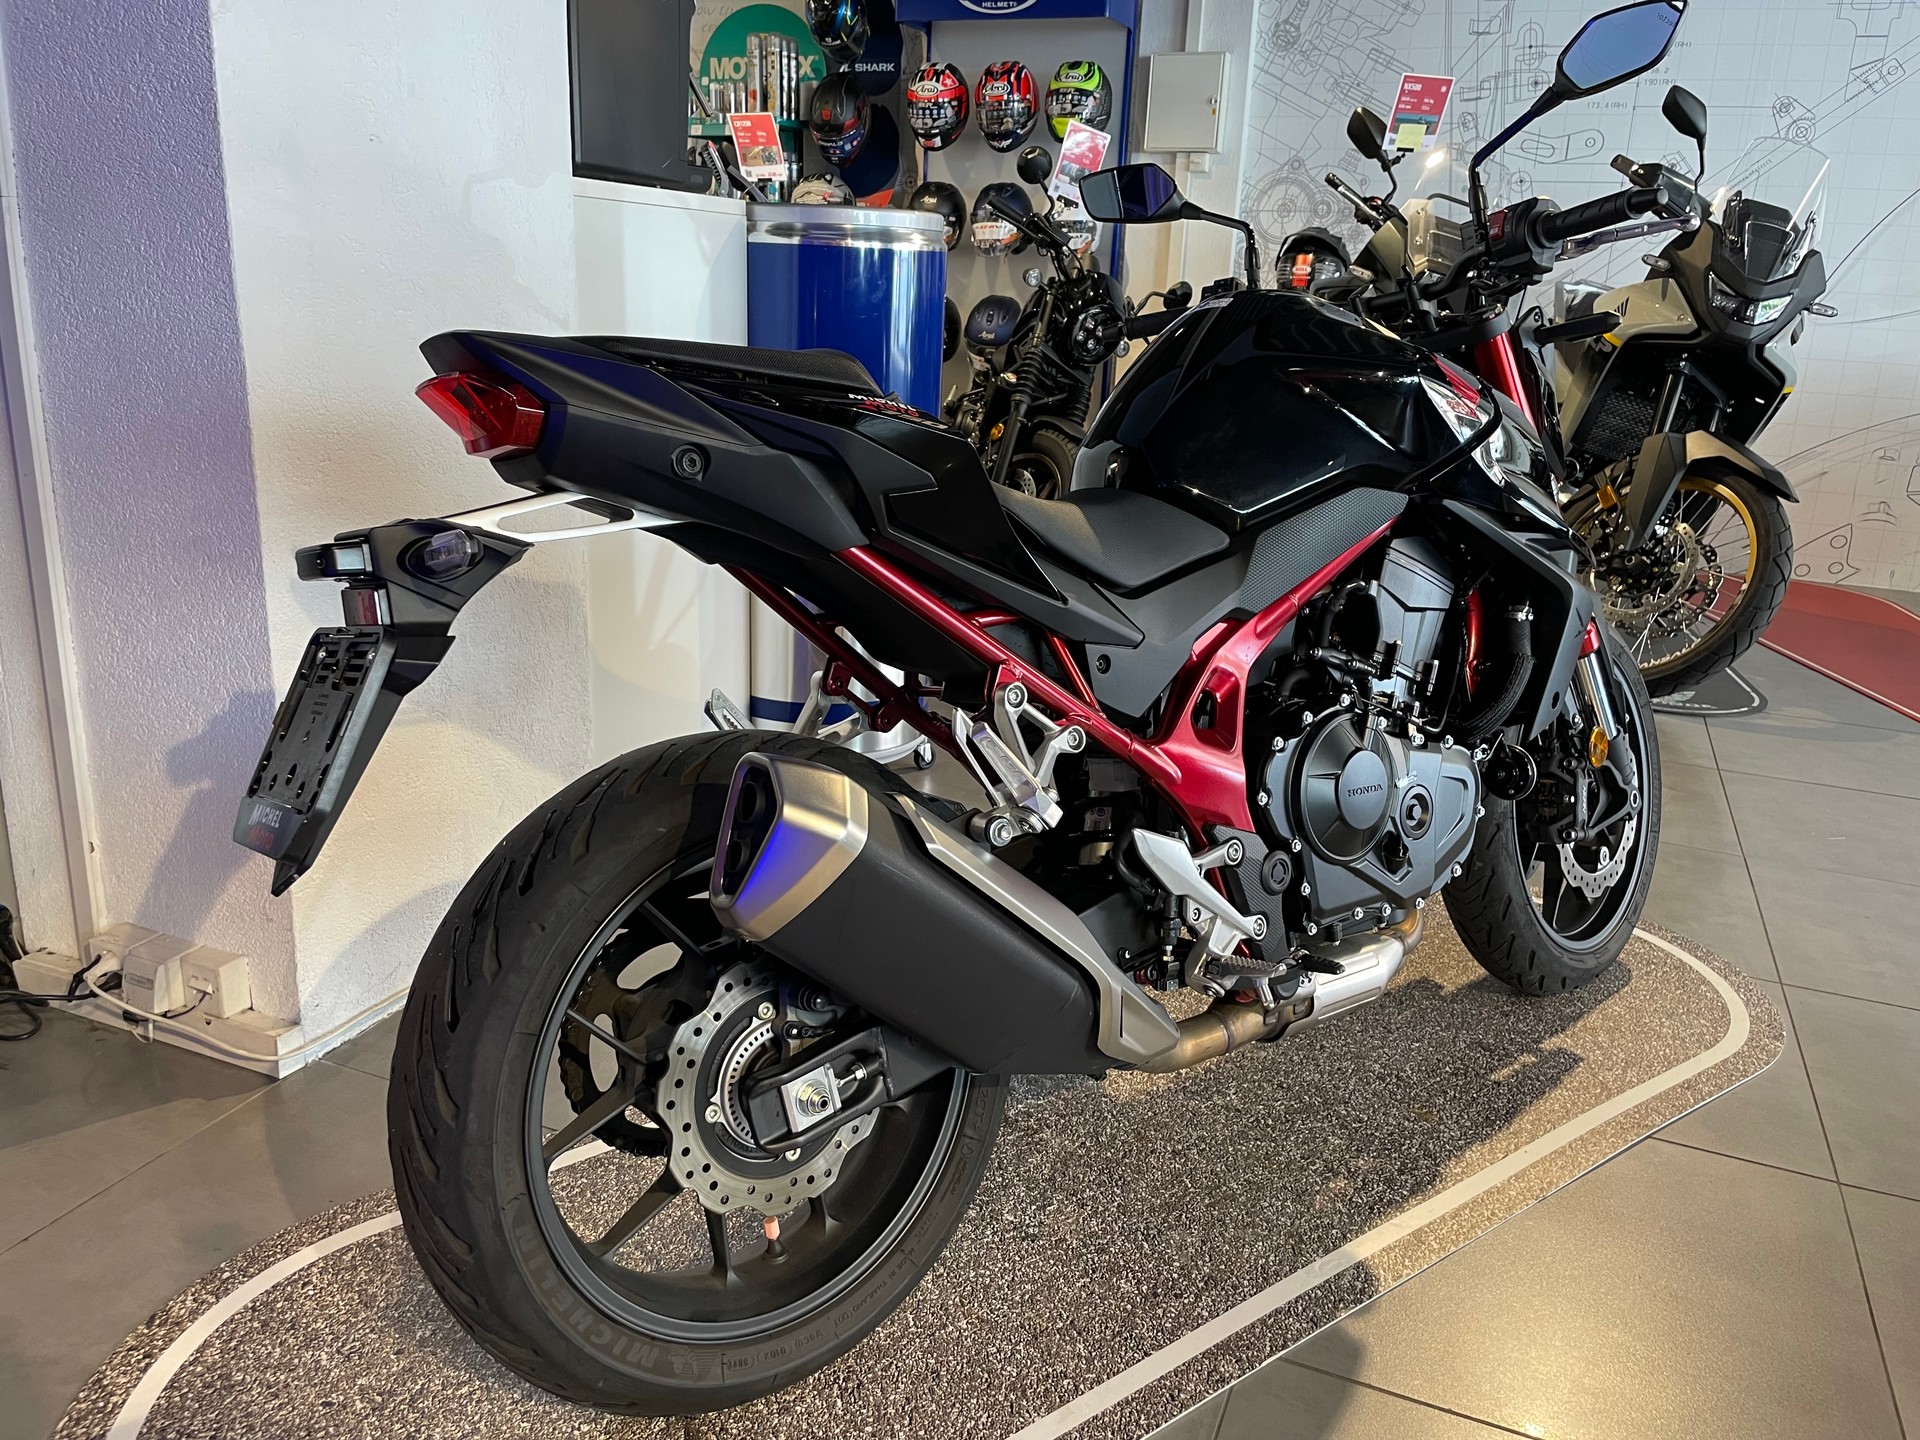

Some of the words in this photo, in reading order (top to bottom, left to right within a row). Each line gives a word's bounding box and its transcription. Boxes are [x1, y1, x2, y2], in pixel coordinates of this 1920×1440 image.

[854, 63, 895, 72] SHARK
[1063, 73, 1080, 81] Arai
[918, 85, 936, 94] Arai
[1403, 82, 1422, 91] NX500
[920, 195, 938, 204] Arai
[978, 330, 995, 340] Arai
[1347, 783, 1383, 797] HONDA
[248, 803, 283, 828] MICHEL
[513, 1222, 660, 1368] MICHELIN
